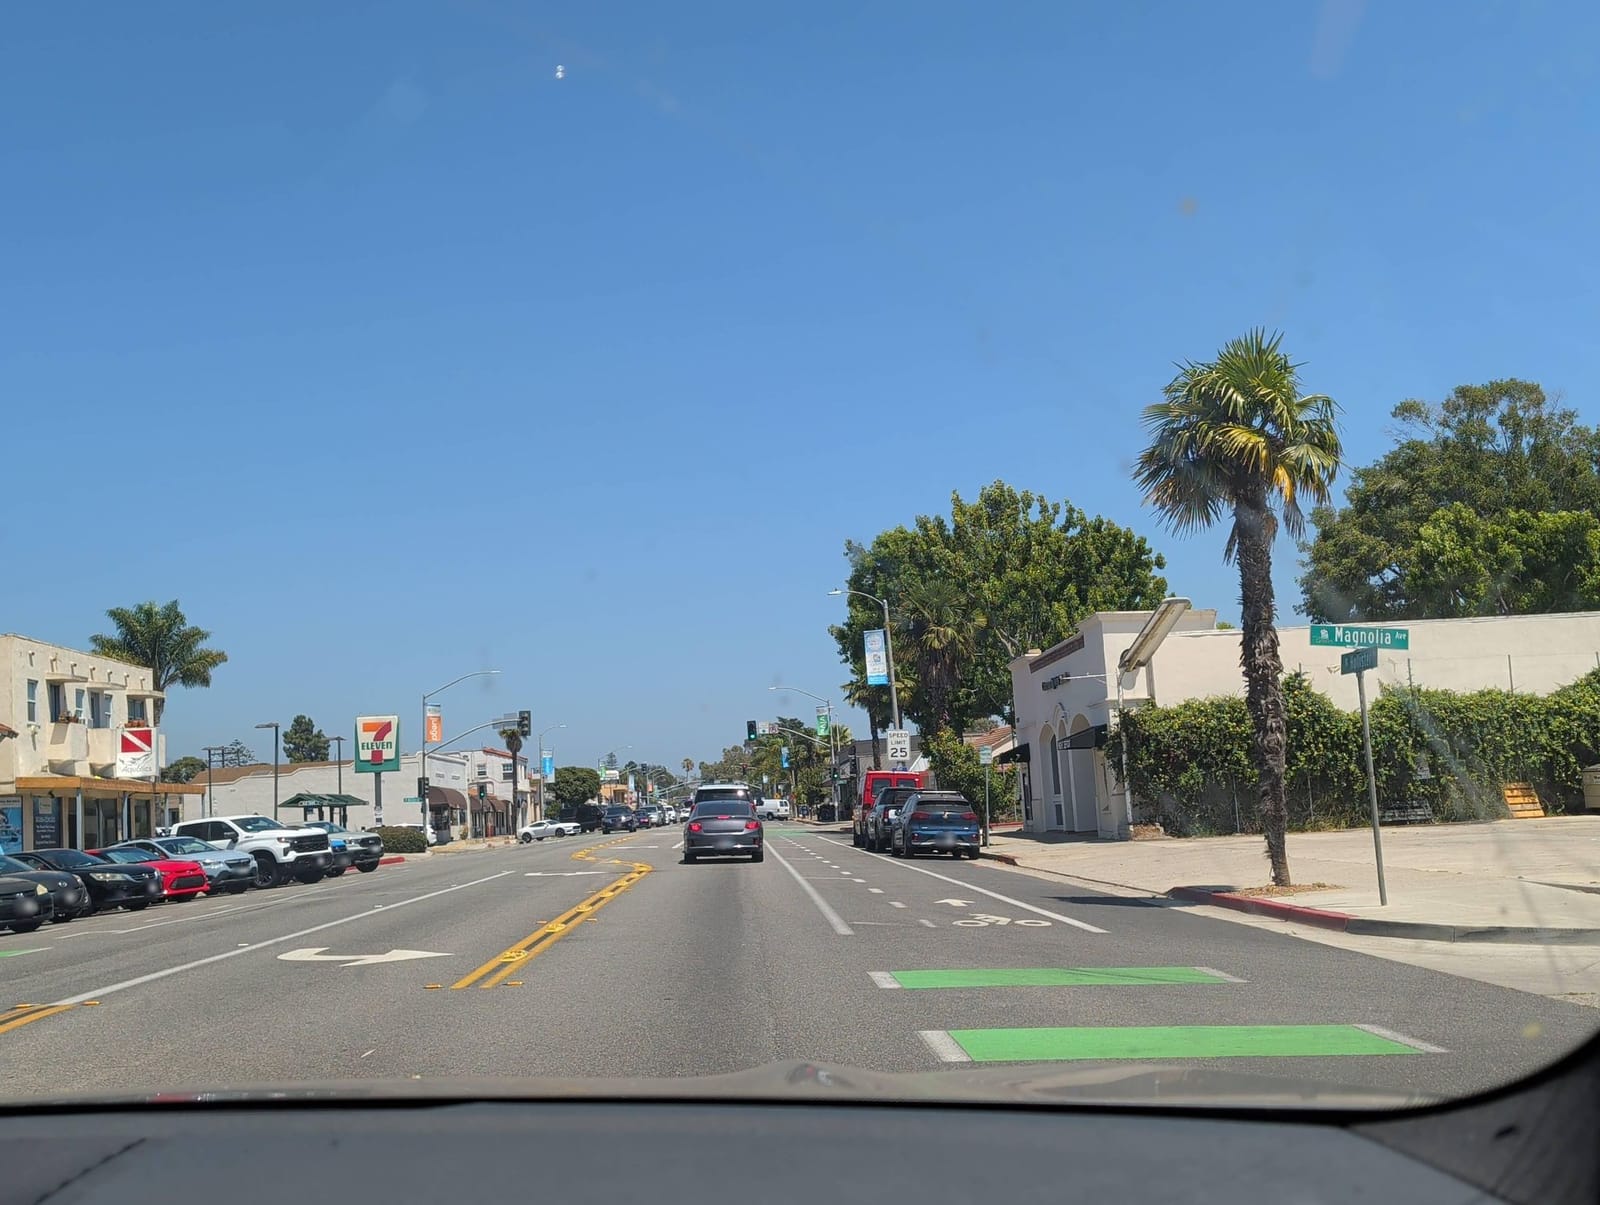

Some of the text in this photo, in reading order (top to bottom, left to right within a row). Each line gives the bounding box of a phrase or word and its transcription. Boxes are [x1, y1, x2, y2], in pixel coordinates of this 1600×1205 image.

[1335, 627, 1407, 646] Magnolia Ave
[362, 720, 392, 764] 7
[890, 747, 908, 758] 25
